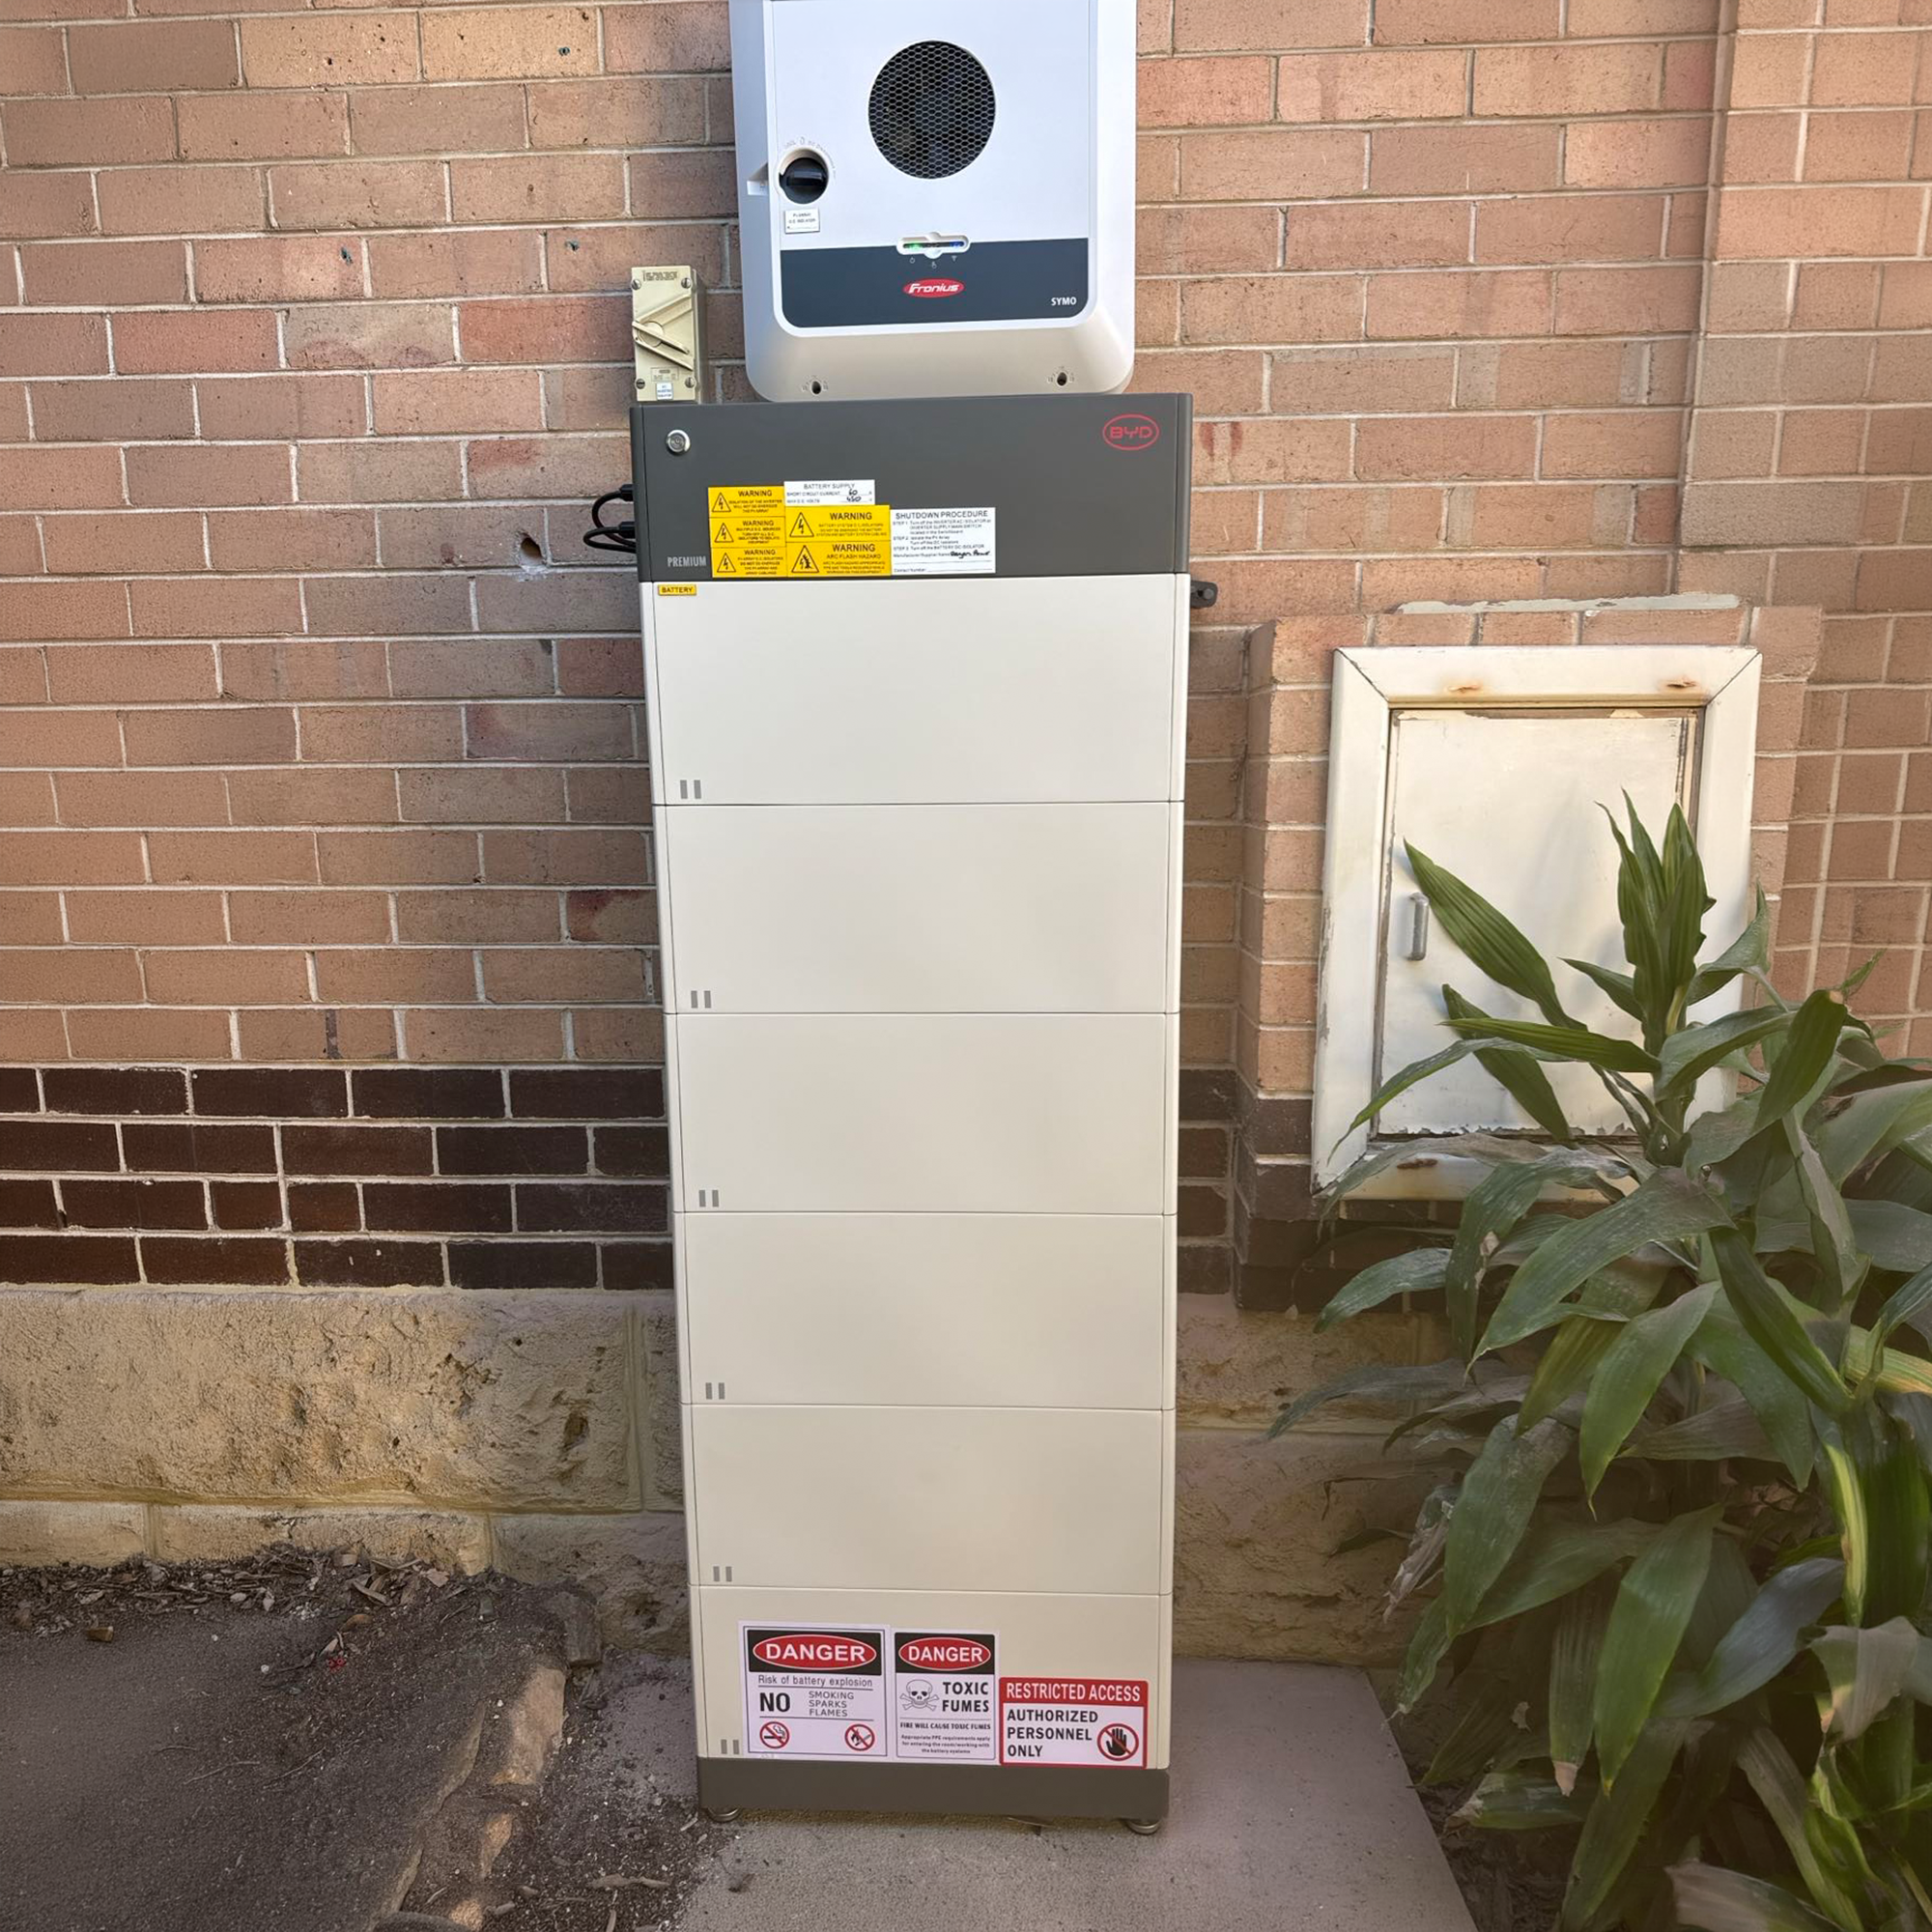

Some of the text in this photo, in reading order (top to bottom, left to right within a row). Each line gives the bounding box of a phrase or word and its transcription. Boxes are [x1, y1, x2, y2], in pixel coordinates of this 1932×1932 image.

[909, 283, 959, 294] Fronius
[1051, 297, 1077, 306] SYMO
[1111, 426, 1152, 439] BYD
[668, 555, 706, 567] PREMIUM
[766, 1643, 867, 1662] DANGER
[908, 1646, 983, 1662] DANGER
[758, 1675, 872, 1688] Risk of battery explosion
[809, 1690, 854, 1700] SMOKING
[943, 1682, 989, 1695] TOXIC
[1007, 1683, 1140, 1702] RESTRICTED ACCESS
[759, 1692, 790, 1712] NO
[943, 1700, 989, 1712] FUMES
[810, 1708, 848, 1717] FLAMES
[1007, 1709, 1098, 1722] AUTHORIZED
[1008, 1727, 1093, 1741] PERSONNEL
[1008, 1745, 1043, 1757] ONLY
